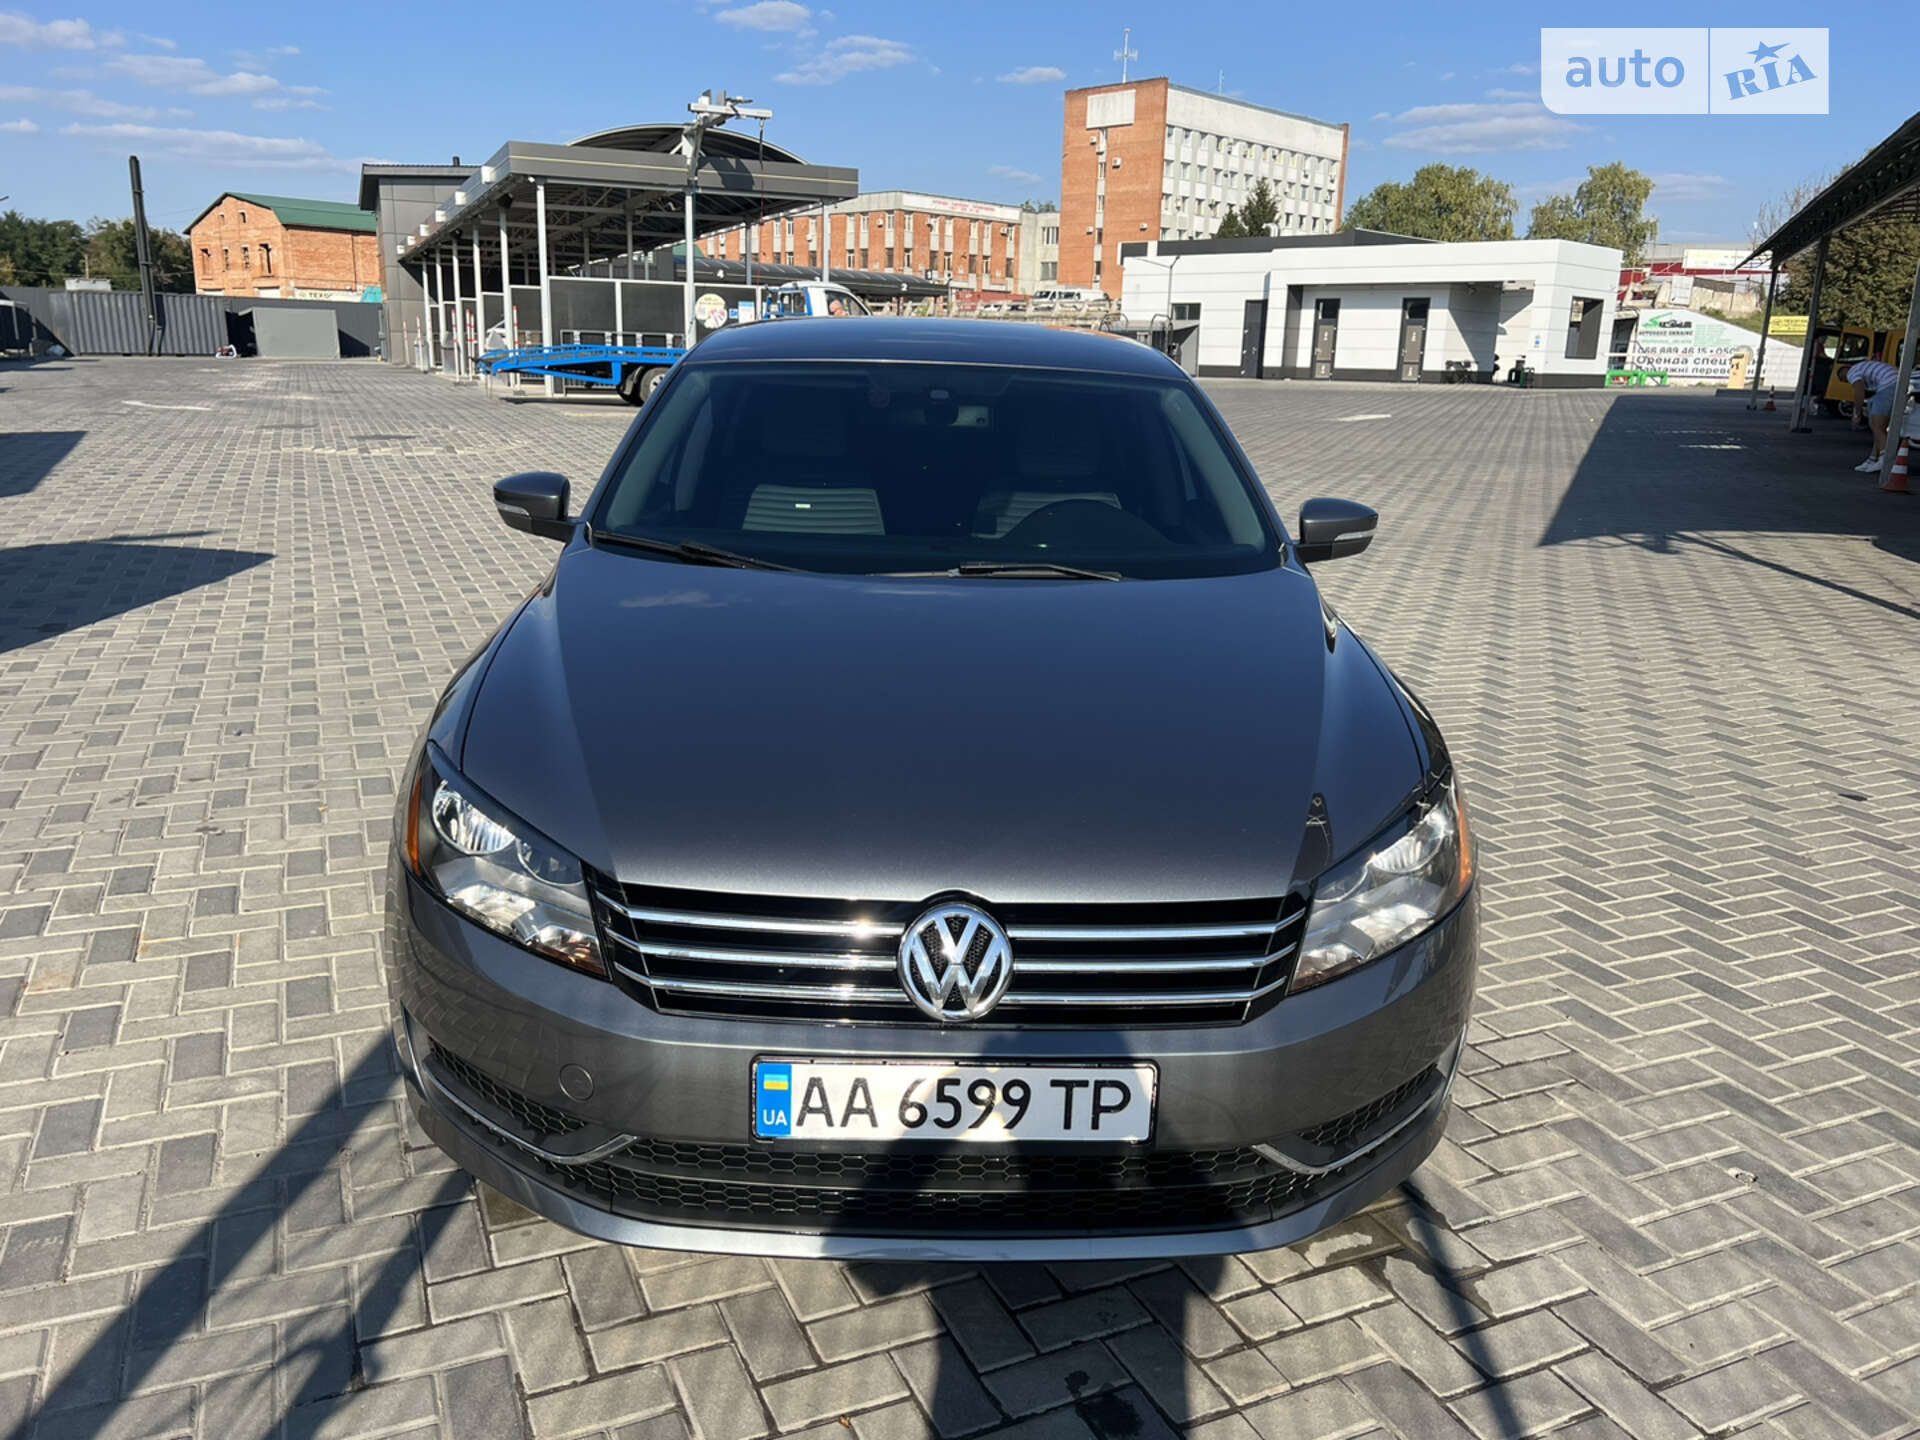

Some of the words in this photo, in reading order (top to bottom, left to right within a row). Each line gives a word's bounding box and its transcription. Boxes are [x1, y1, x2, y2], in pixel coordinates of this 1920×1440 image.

[1636, 356, 1689, 365] Оренда
[795, 1077, 879, 1128] AA
[898, 1077, 1032, 1130] 6599
[1049, 1078, 1132, 1131] TP
[762, 1109, 788, 1126] UA
